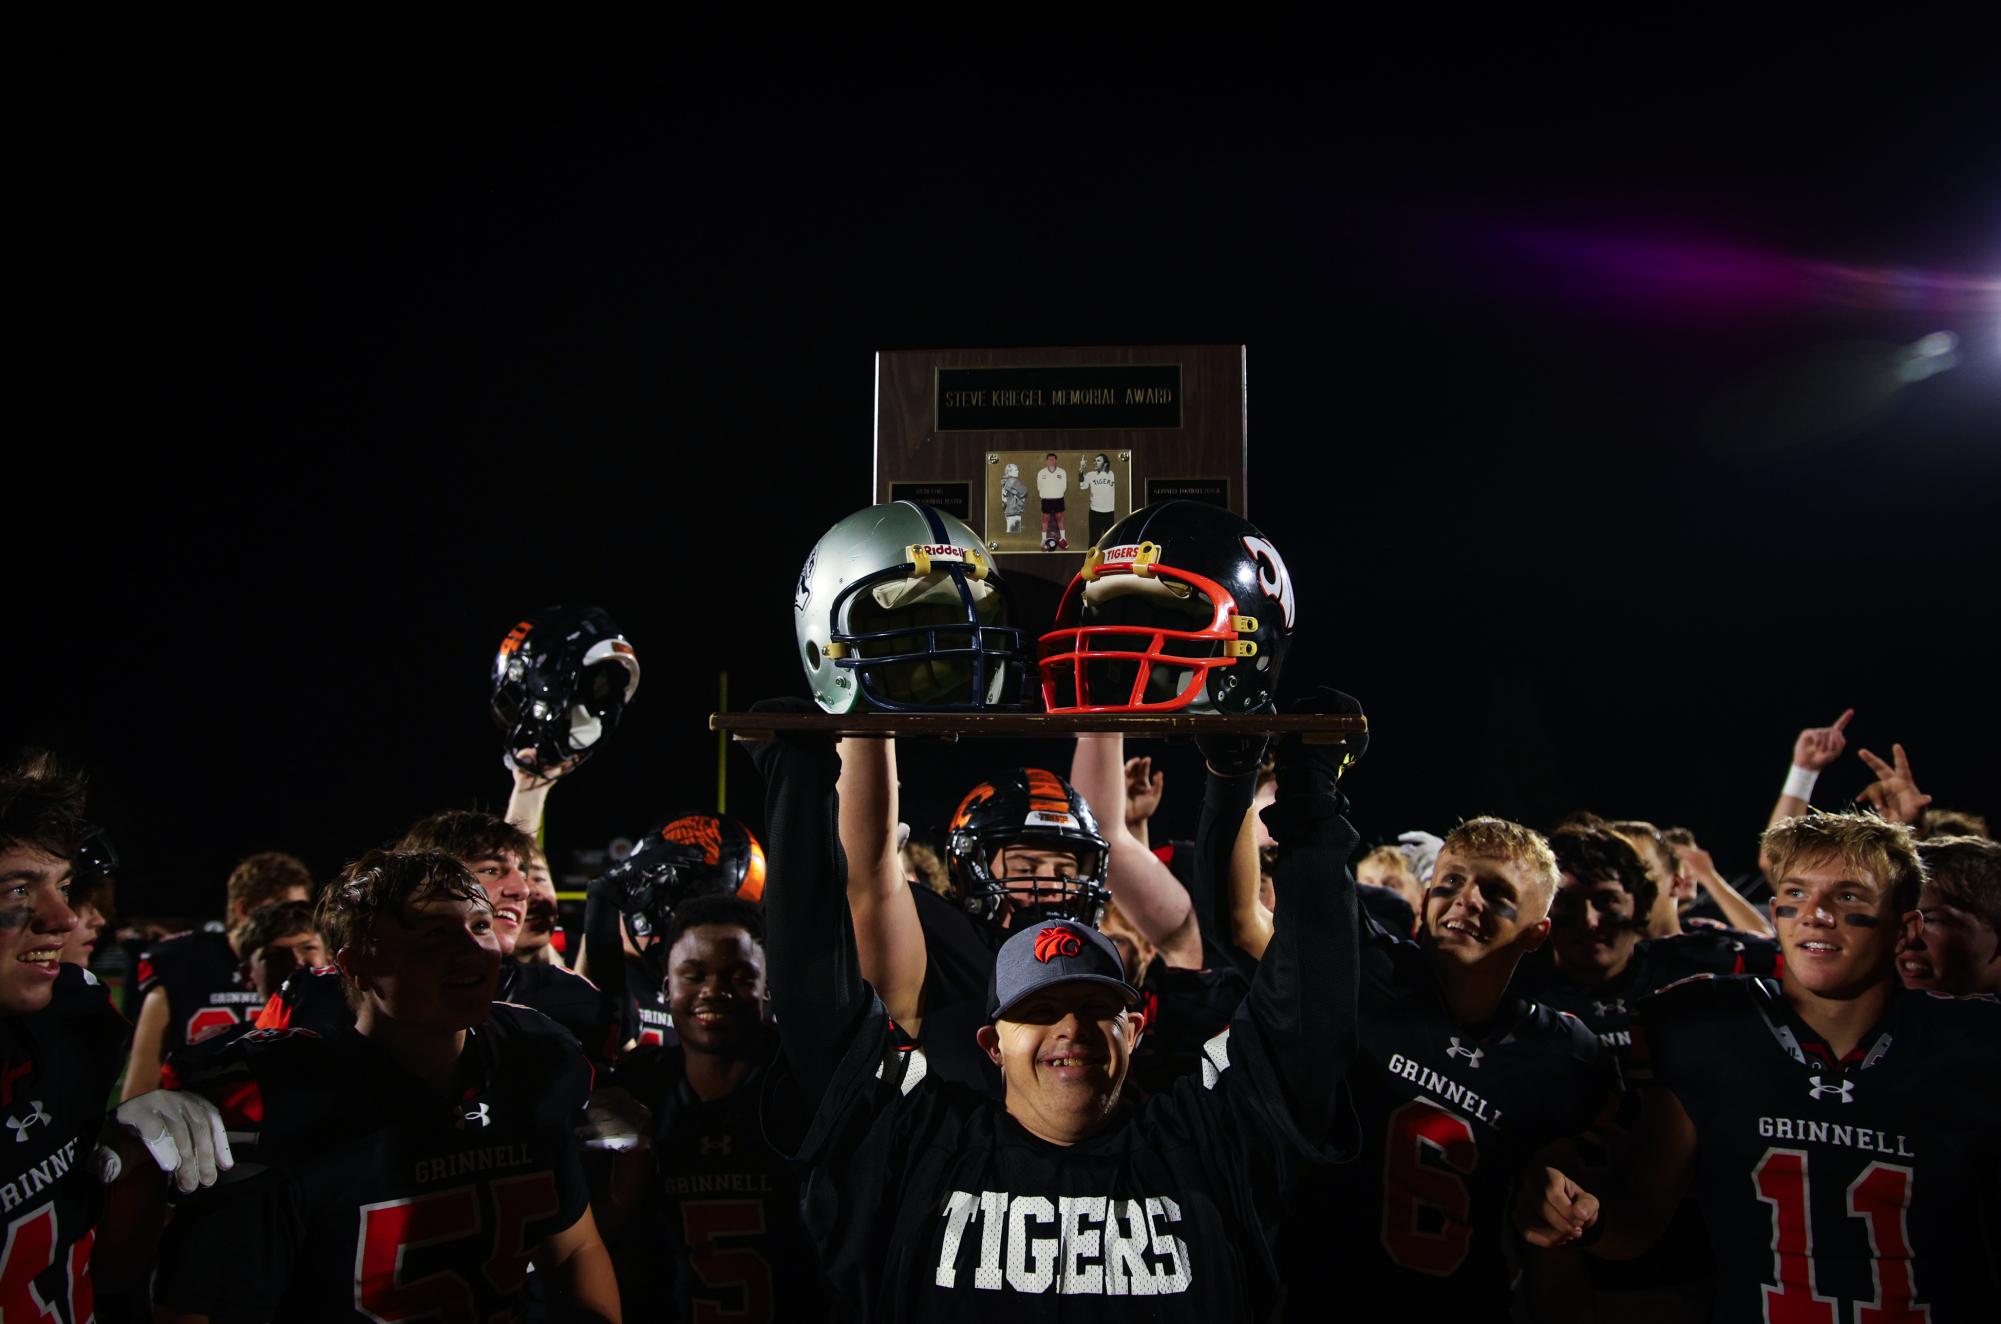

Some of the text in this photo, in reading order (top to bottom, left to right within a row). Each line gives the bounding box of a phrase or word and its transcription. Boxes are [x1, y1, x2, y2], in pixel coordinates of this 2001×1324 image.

[945, 386, 1173, 408] STEVE KRIEGEL MEMORIAL AWARD
[1092, 478, 1115, 487] TIGERS
[1106, 547, 1139, 561] TIGERS
[1388, 1053, 1504, 1131] GRINNELL
[1758, 1116, 1915, 1158] GRINNELL
[415, 1143, 533, 1184] GRINNELL
[664, 1173, 774, 1195] GRINNELL
[1380, 1095, 1480, 1278] 6
[936, 1190, 1193, 1296] TIGERS
[1751, 1147, 1934, 1324] 11
[680, 1198, 777, 1324] 5
